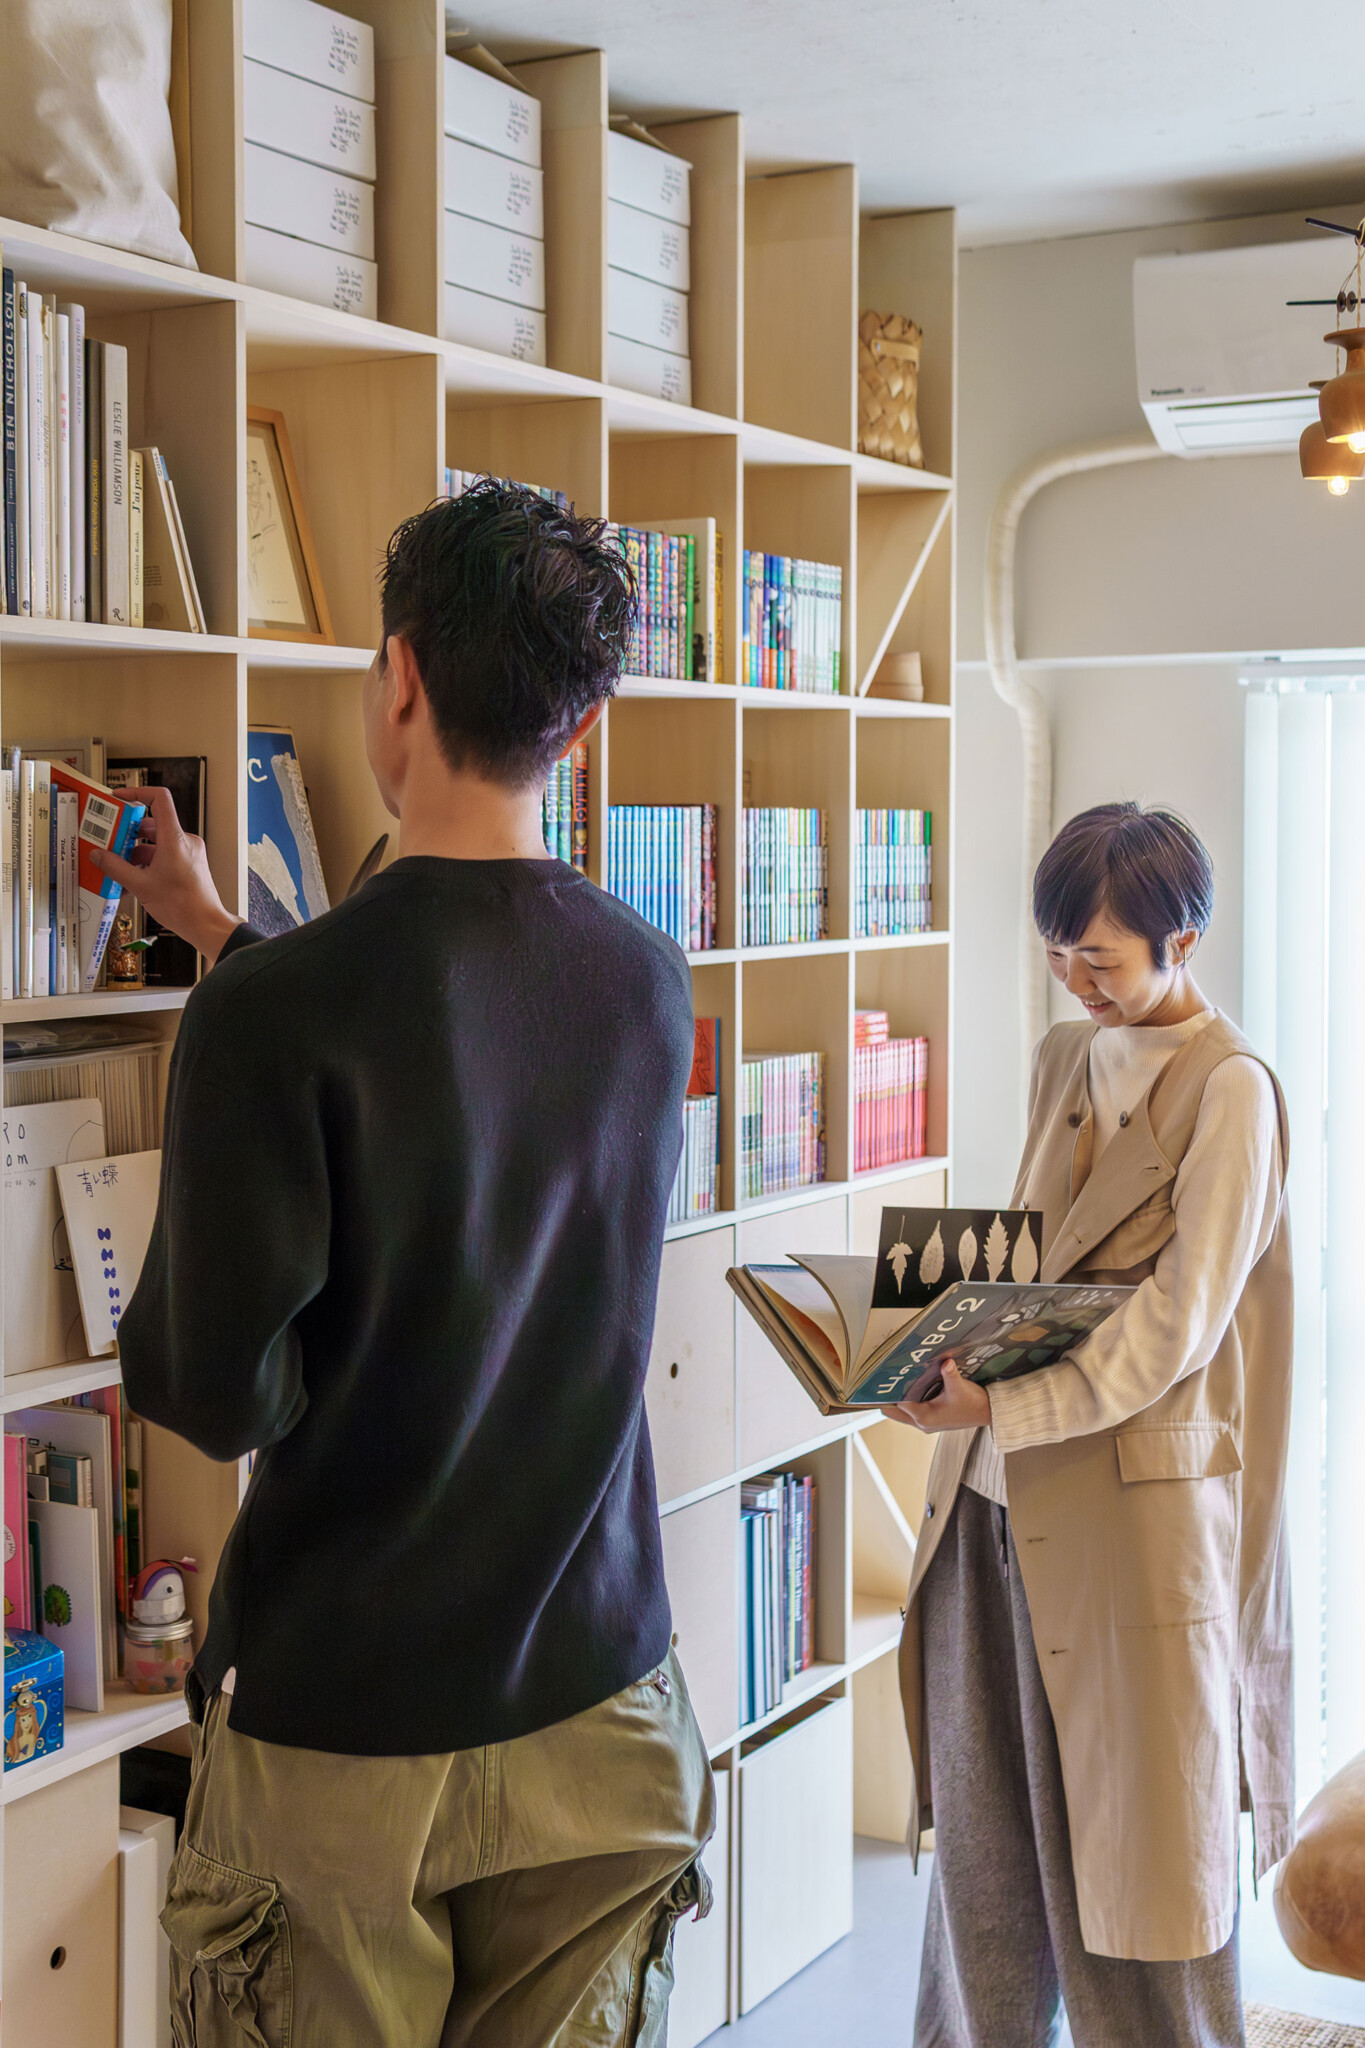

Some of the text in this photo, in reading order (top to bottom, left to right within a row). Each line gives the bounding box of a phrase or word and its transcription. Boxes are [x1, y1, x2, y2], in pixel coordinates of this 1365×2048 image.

[5, 291, 15, 450] BEN NICHOLSON
[112, 401, 122, 506] LESLIE WILLIAMSON
[131, 461, 142, 489] peur
[576, 767, 588, 809] AKIRA
[76, 1163, 119, 1197] 青い蝶
